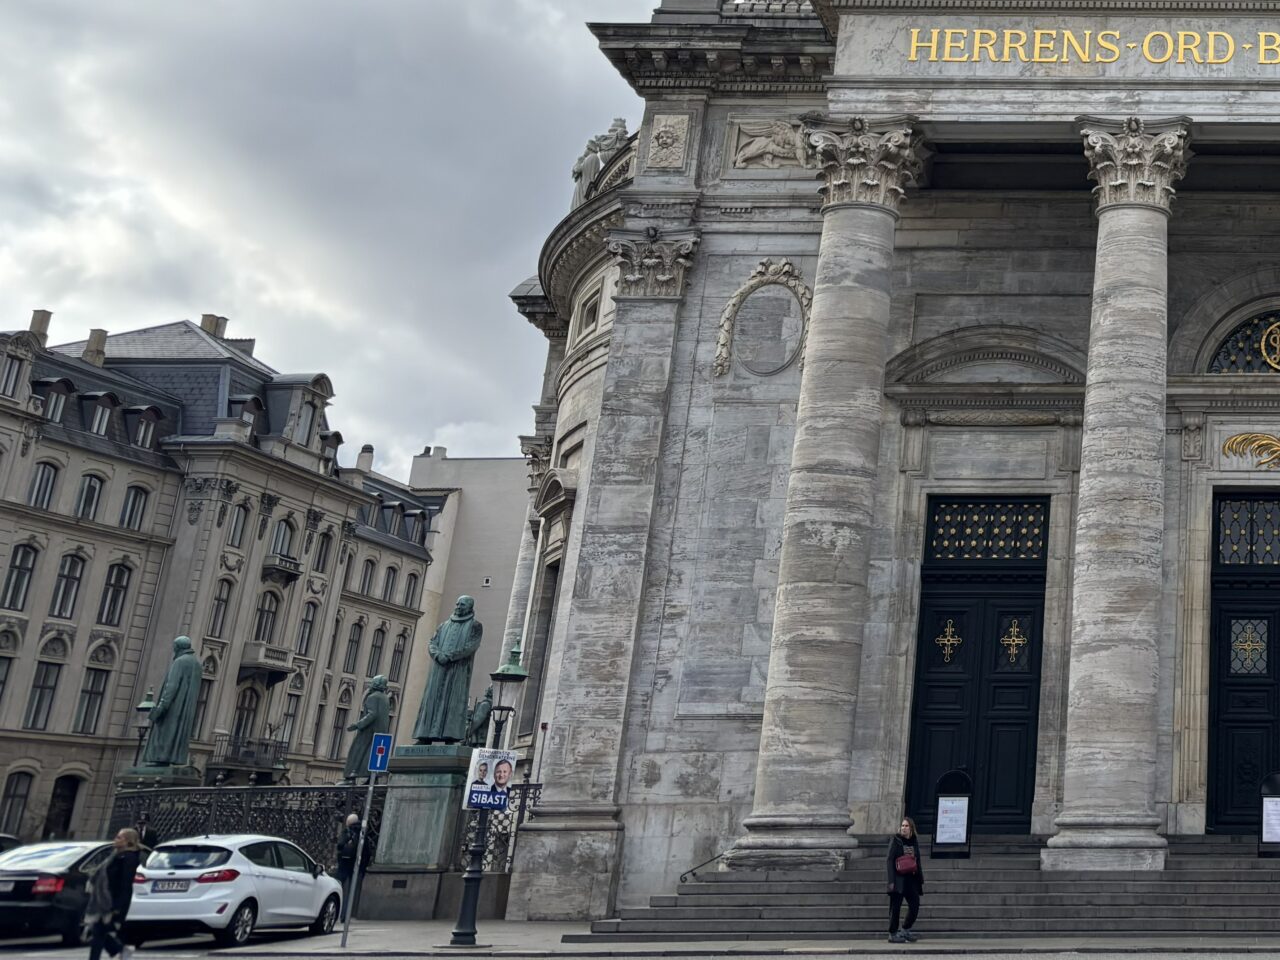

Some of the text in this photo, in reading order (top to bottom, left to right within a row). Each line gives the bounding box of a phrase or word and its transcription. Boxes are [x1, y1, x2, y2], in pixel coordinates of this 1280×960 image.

[907, 27, 1121, 64] HERRENS
[1141, 30, 1236, 65] ORD
[471, 793, 506, 805] SIBAST
